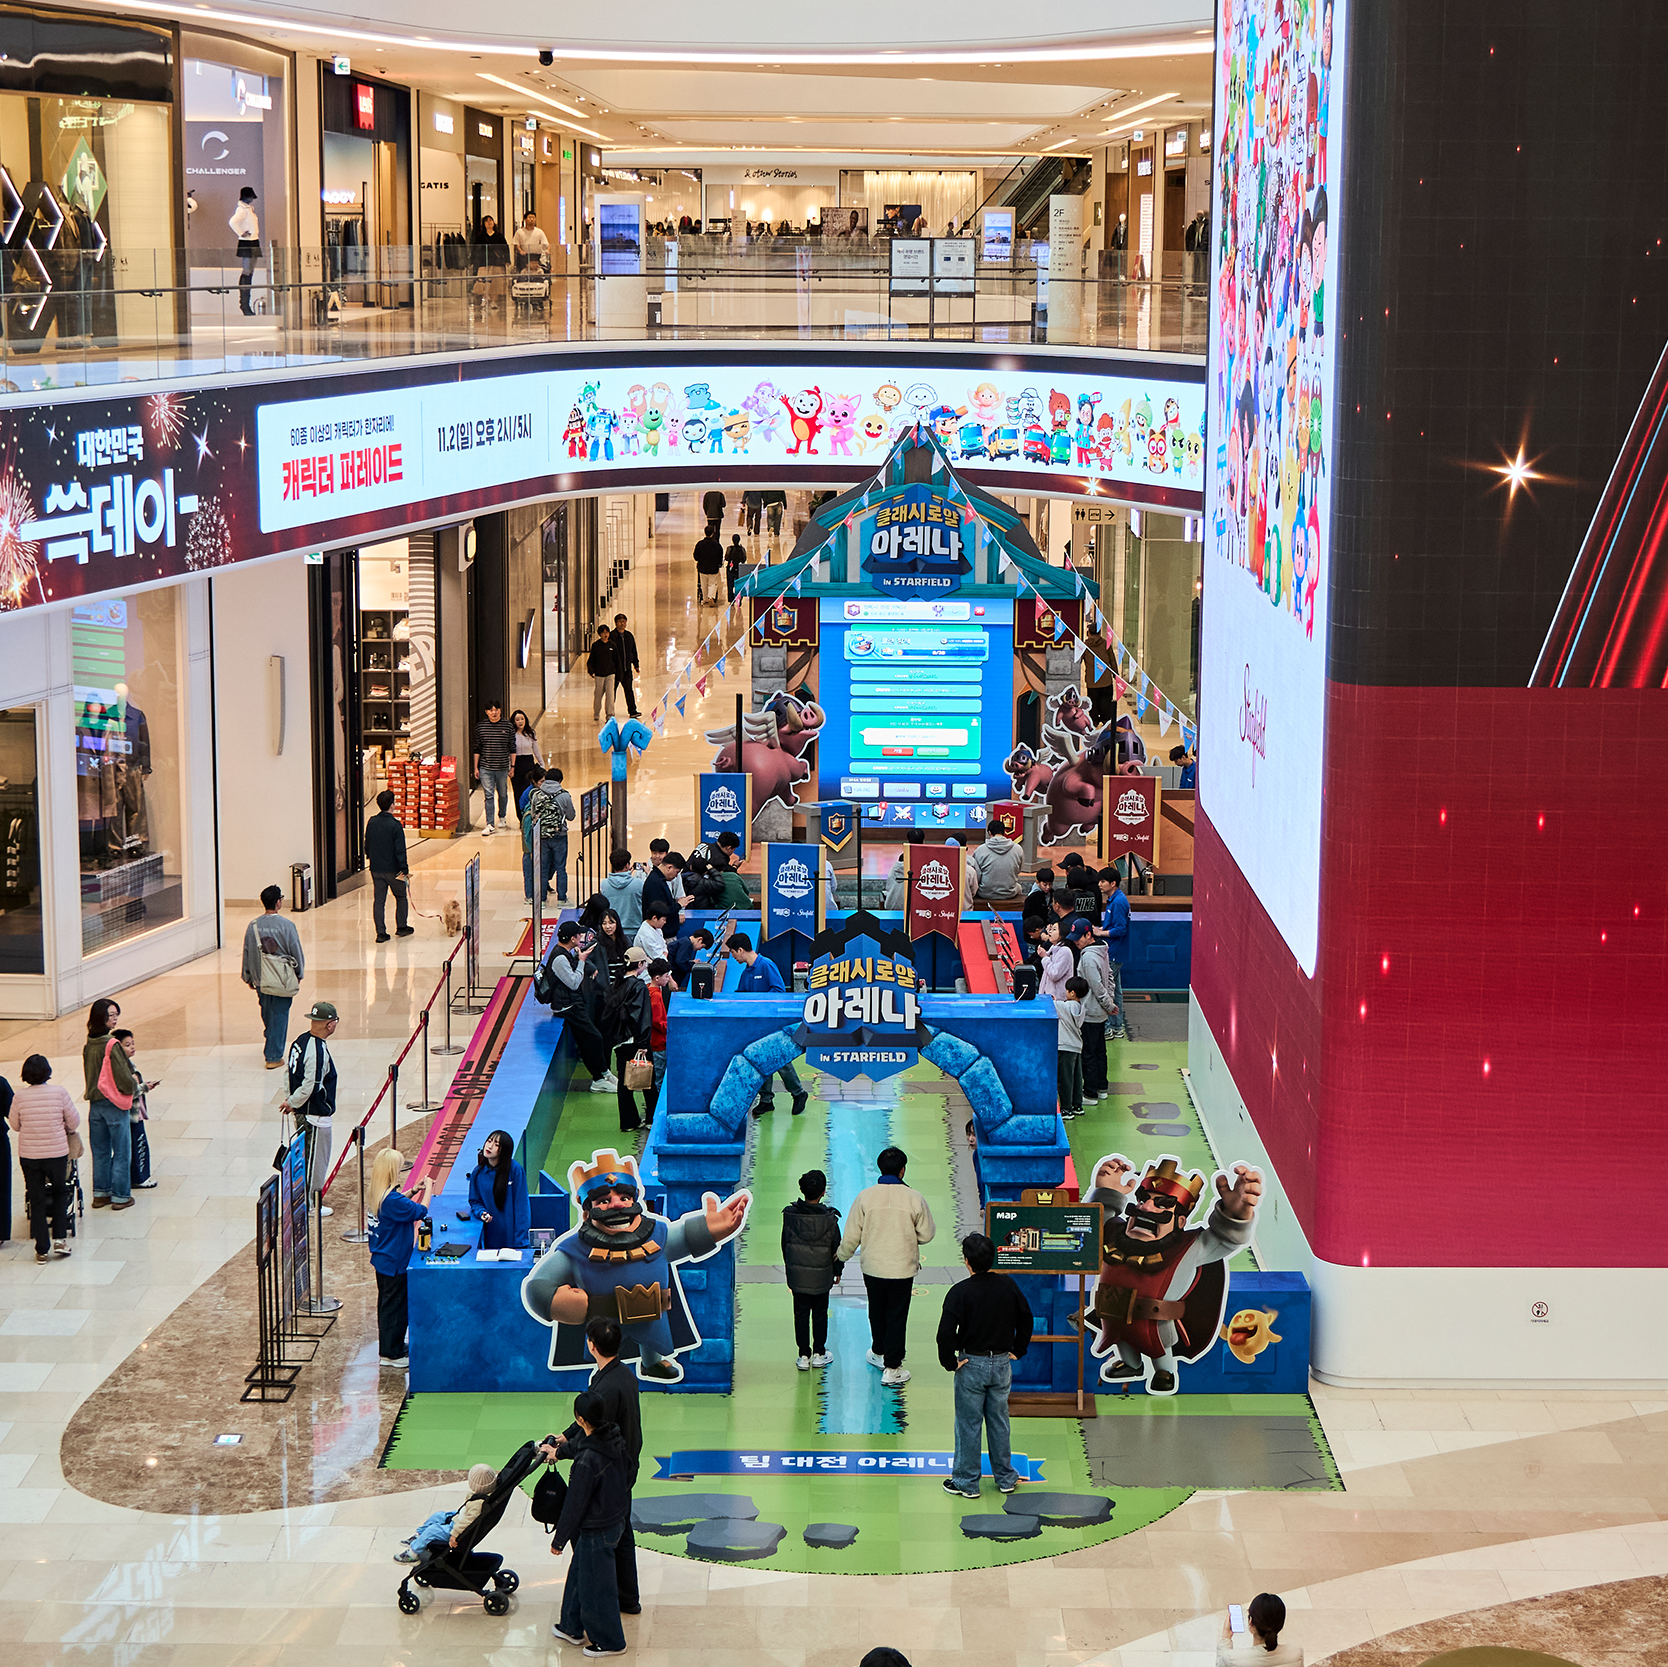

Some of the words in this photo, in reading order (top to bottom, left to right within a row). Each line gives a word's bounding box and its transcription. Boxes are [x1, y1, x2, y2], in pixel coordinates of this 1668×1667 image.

[186, 167, 247, 175] CHALLENGER
[1054, 208, 1065, 217] 2F
[290, 426, 308, 447] 60종
[309, 423, 333, 443] 이상의
[334, 419, 363, 440] 캐릭터가
[364, 414, 395, 436] 한자리에!
[437, 421, 473, 452] 11.2(일)
[475, 417, 495, 447] 오후
[497, 412, 532, 442] 2시/5시
[77, 425, 144, 468] 대한민국
[282, 453, 335, 501] 캐릭터
[339, 442, 403, 491] 퍼레이드
[875, 502, 960, 528] 클래시로얄
[870, 525, 963, 561] 아레나
[893, 577, 951, 587] STARFIELD
[710, 798, 737, 809] 아레나
[1118, 801, 1146, 812] 아레나
[809, 957, 917, 989] 클래시로얄
[803, 986, 921, 1030] 아레나
[833, 1051, 907, 1063] STARFIELD
[739, 1455, 770, 1468] 팀
[781, 1456, 847, 1469] 대전
